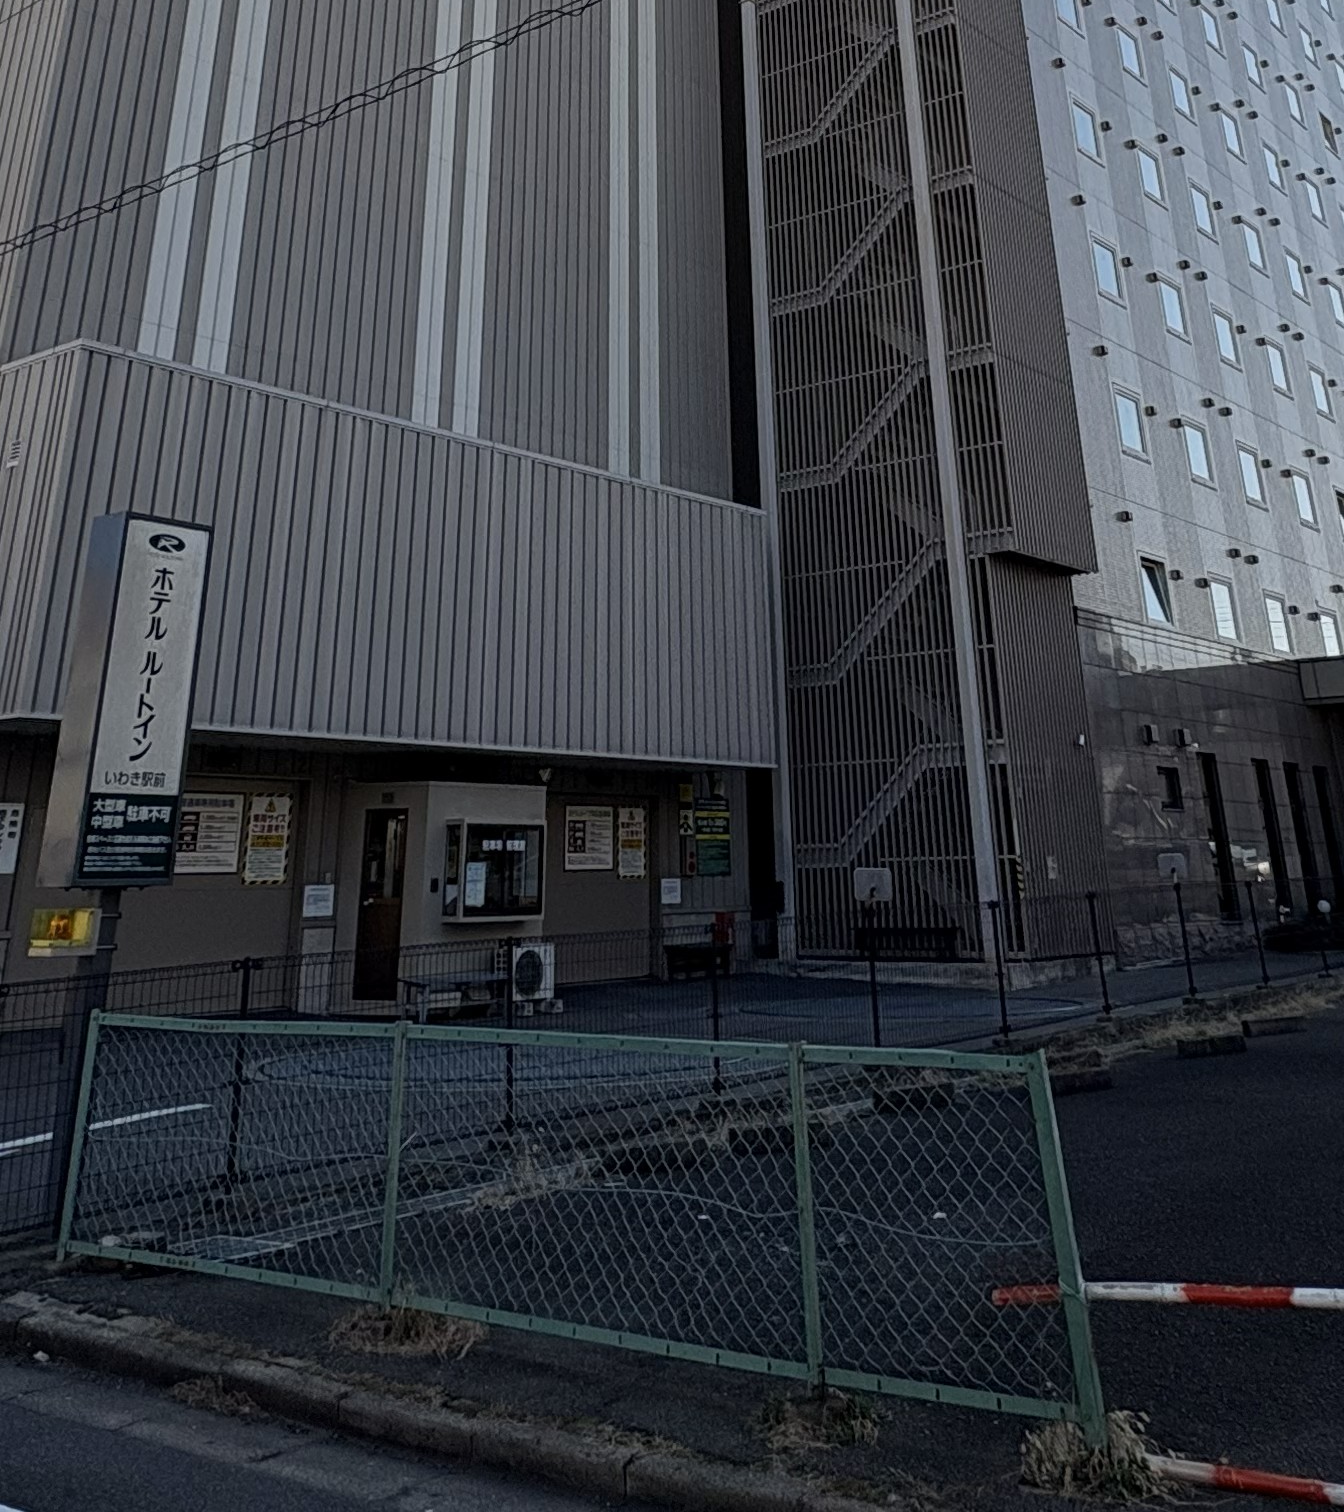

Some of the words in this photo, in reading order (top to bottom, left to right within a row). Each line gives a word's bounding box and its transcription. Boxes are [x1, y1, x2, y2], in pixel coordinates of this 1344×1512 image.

[144, 567, 174, 640] ホテル
[128, 651, 163, 763] ルートイン
[104, 770, 167, 789] いわき駅前
[126, 805, 173, 824] 駐車不可
